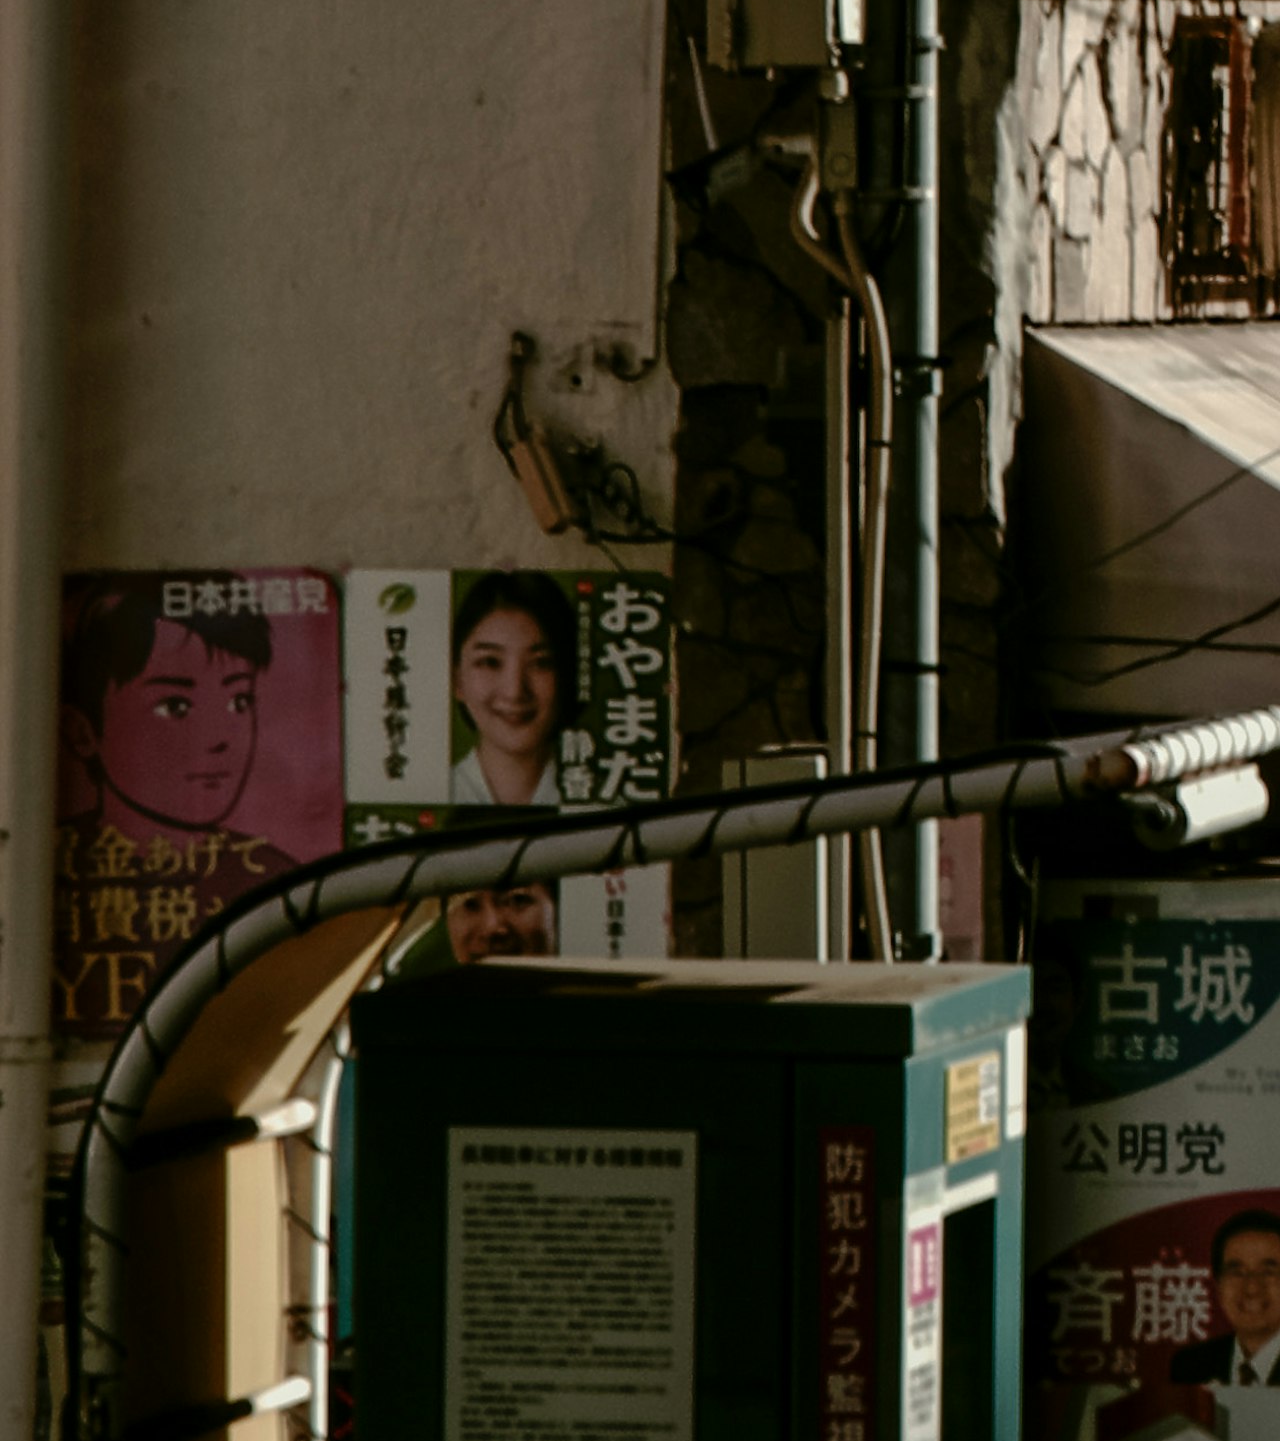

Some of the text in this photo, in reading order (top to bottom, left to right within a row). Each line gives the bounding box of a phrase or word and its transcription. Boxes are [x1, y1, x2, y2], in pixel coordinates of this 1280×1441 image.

[162, 580, 329, 618] 日本共産党
[598, 582, 665, 802] おやまだ
[558, 728, 597, 801] 静香
[1090, 943, 1256, 1026] 古城
[1062, 1123, 1226, 1176] 公明党
[1047, 1262, 1211, 1343] 斉藤
